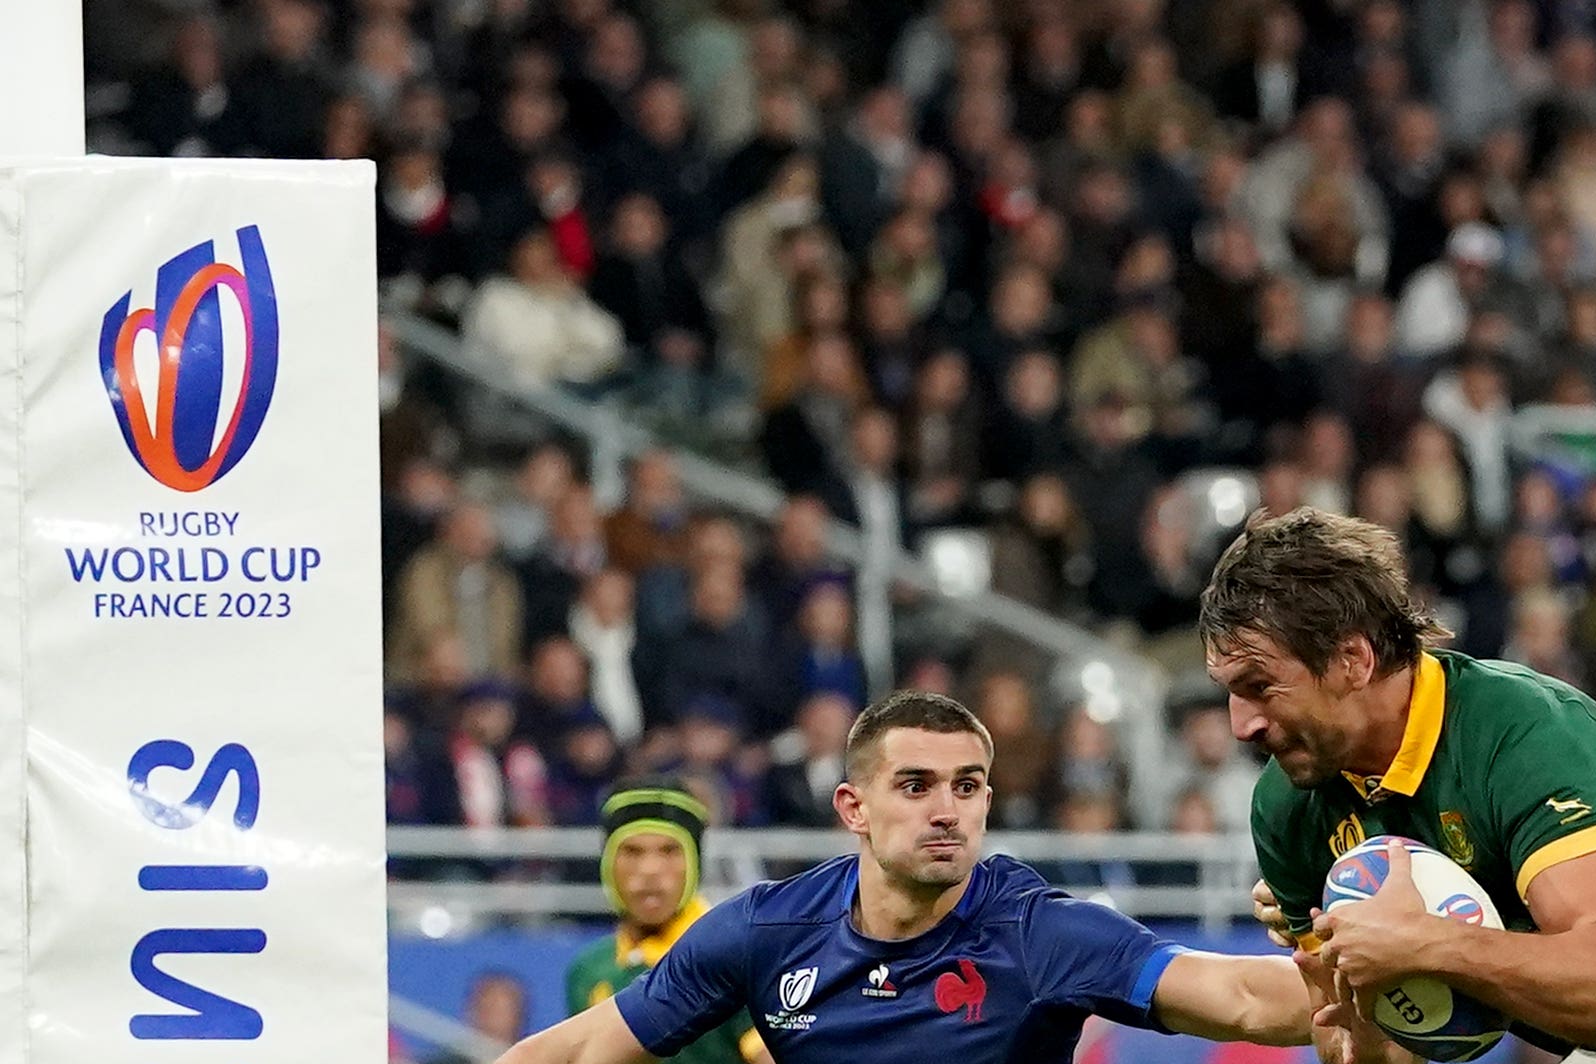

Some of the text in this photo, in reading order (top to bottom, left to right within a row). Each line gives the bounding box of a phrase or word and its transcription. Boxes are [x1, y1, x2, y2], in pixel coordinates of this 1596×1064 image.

[139, 511, 240, 537] RUGBY
[64, 546, 321, 582] WORLD CUP
[94, 592, 292, 618] FRANCE 2023
[797, 1014, 818, 1025] CUP
